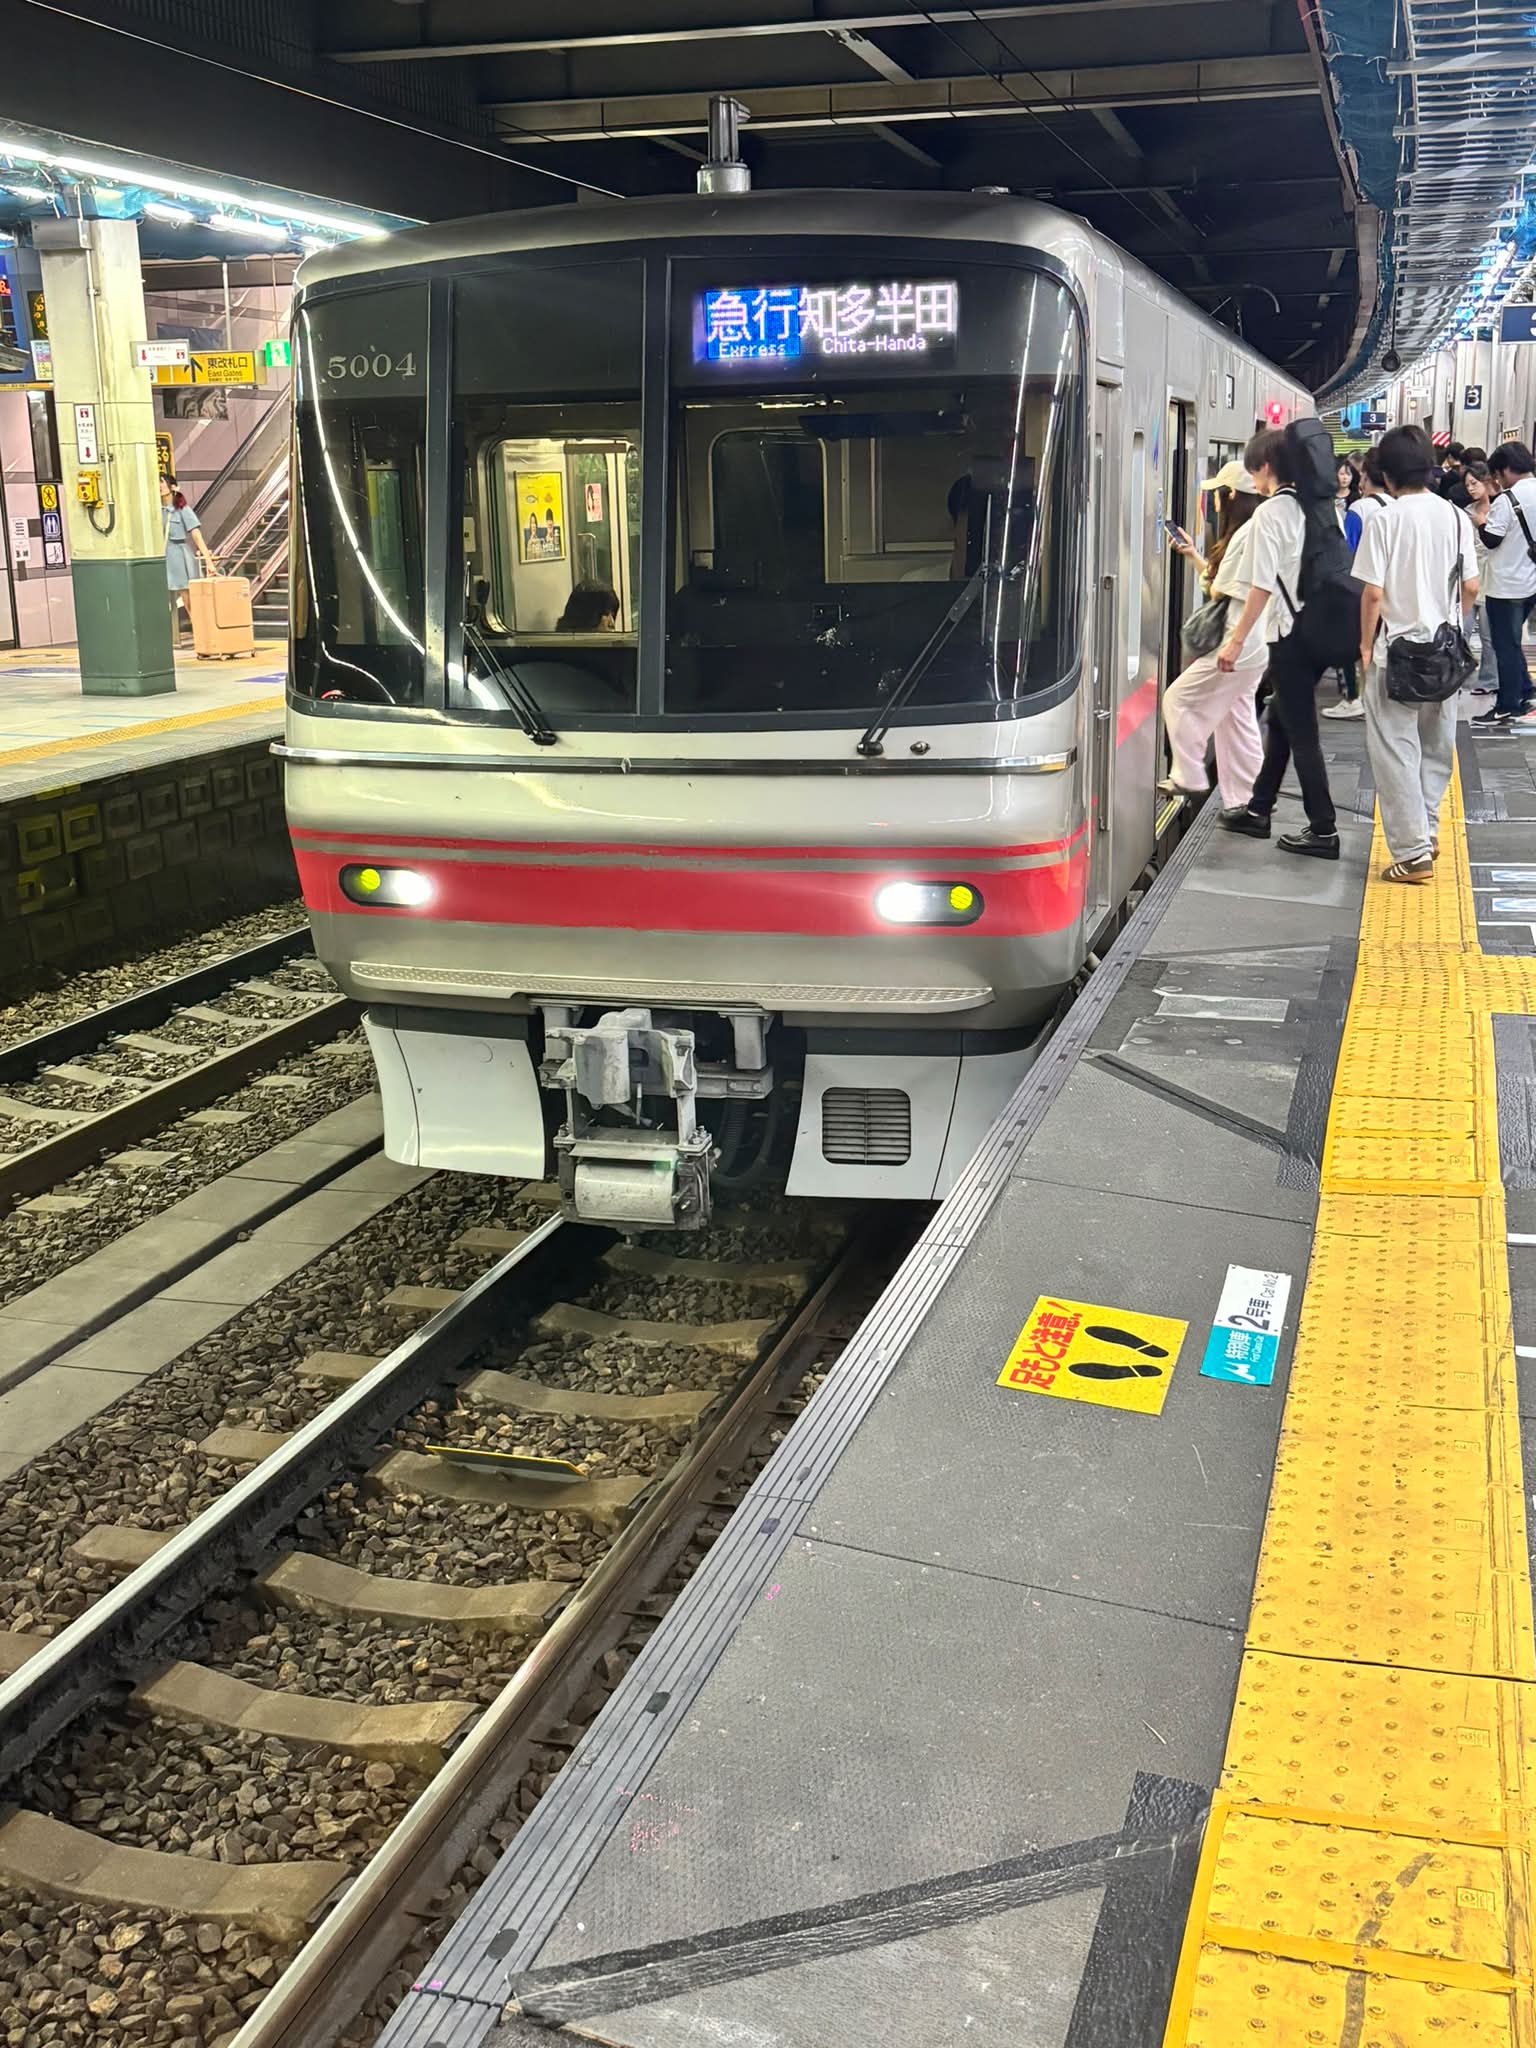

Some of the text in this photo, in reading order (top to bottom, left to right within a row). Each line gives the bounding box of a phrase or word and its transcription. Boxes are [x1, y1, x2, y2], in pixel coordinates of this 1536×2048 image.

[707, 289, 796, 342] 急行
[798, 283, 953, 338] 知多半田
[719, 342, 786, 359] Express
[822, 333, 927, 354] Chita-Handa
[207, 356, 248, 369] 東改札口
[327, 352, 417, 379] 5004
[1369, 414, 1377, 423] 3
[1227, 1297, 1273, 1331] 2号車
